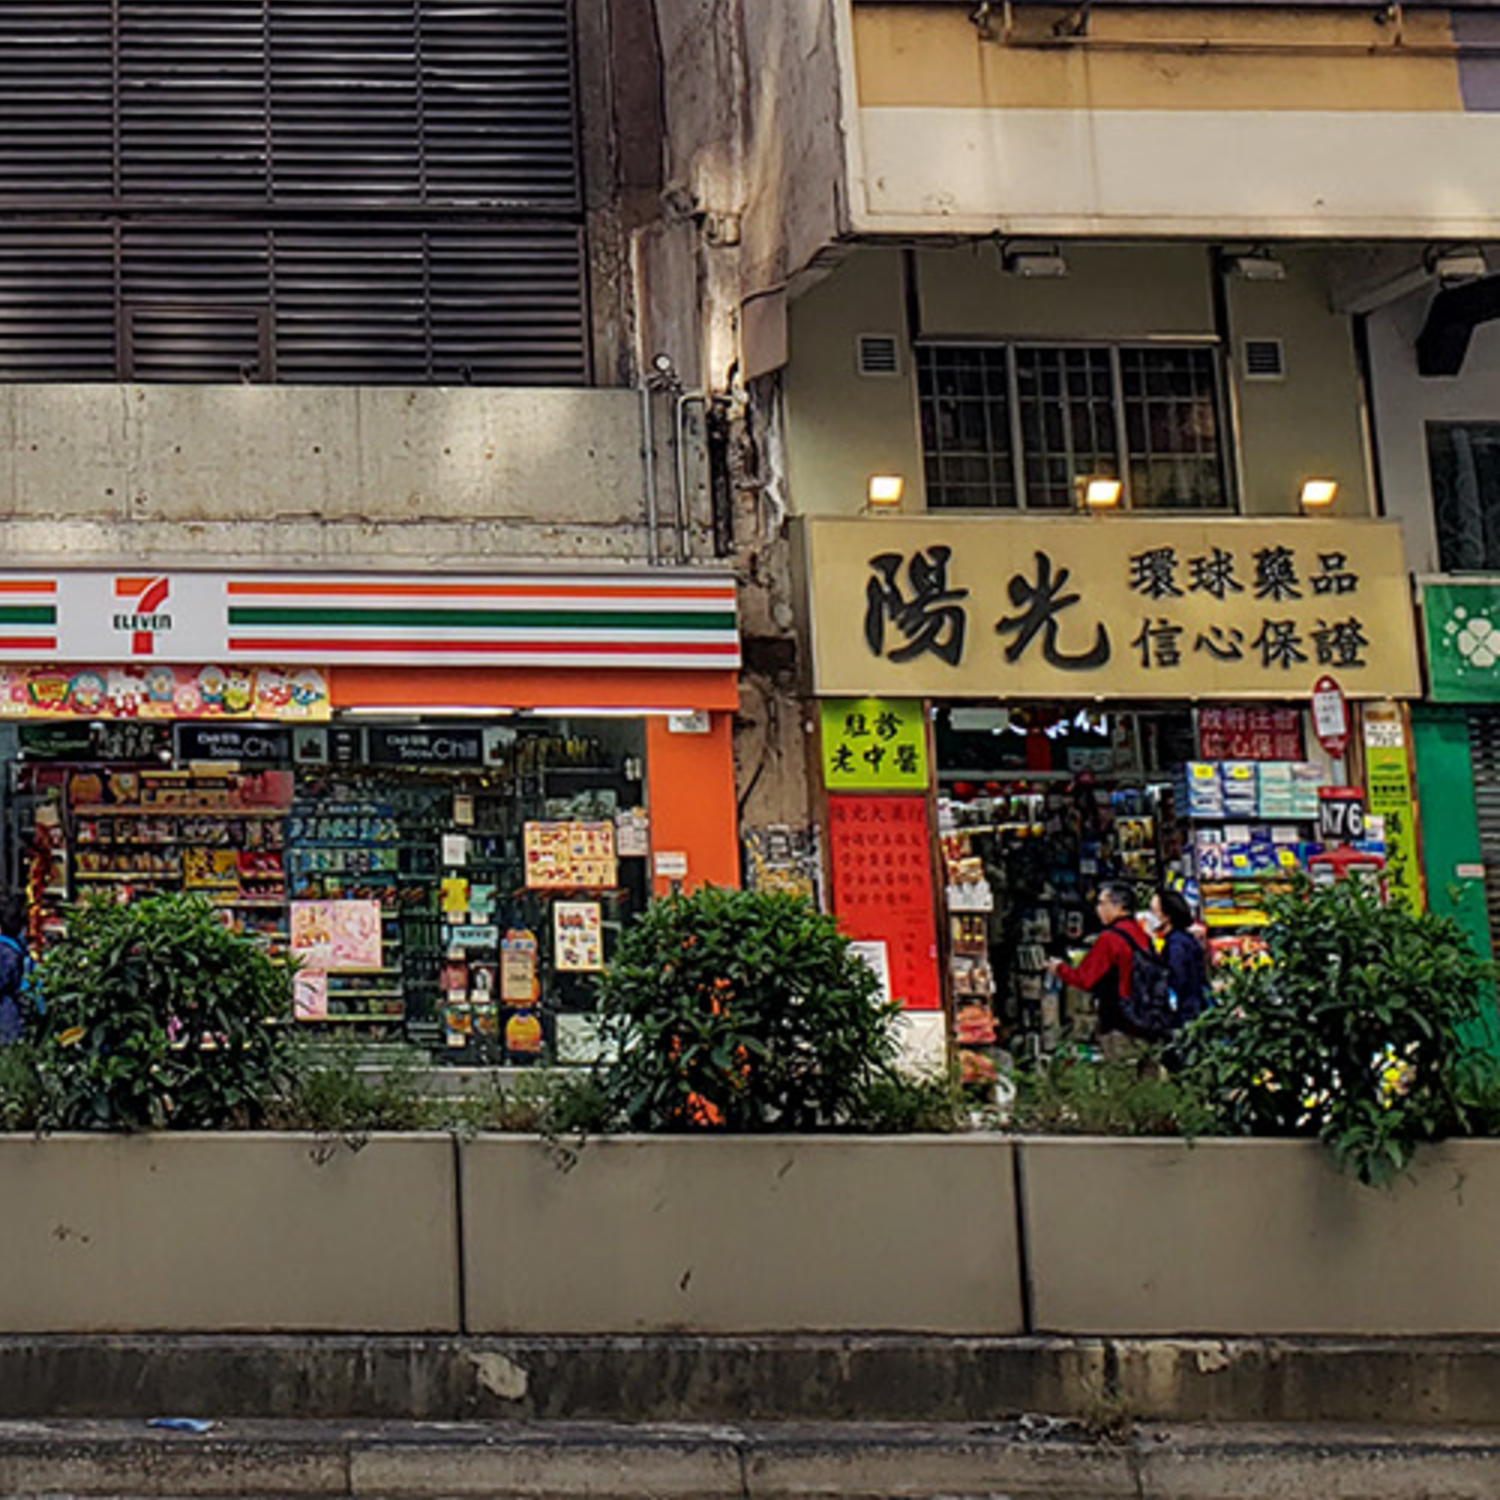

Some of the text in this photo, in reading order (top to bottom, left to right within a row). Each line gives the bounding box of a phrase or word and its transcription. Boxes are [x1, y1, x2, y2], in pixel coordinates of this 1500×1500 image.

[112, 614, 172, 630] ELEVEN
[864, 545, 1360, 671] 陽光 環球藥品
[1131, 617, 1369, 669] 信心保證
[843, 710, 904, 741] 駐診
[830, 743, 919, 776] 老中醫
[1321, 803, 1363, 837] N76
